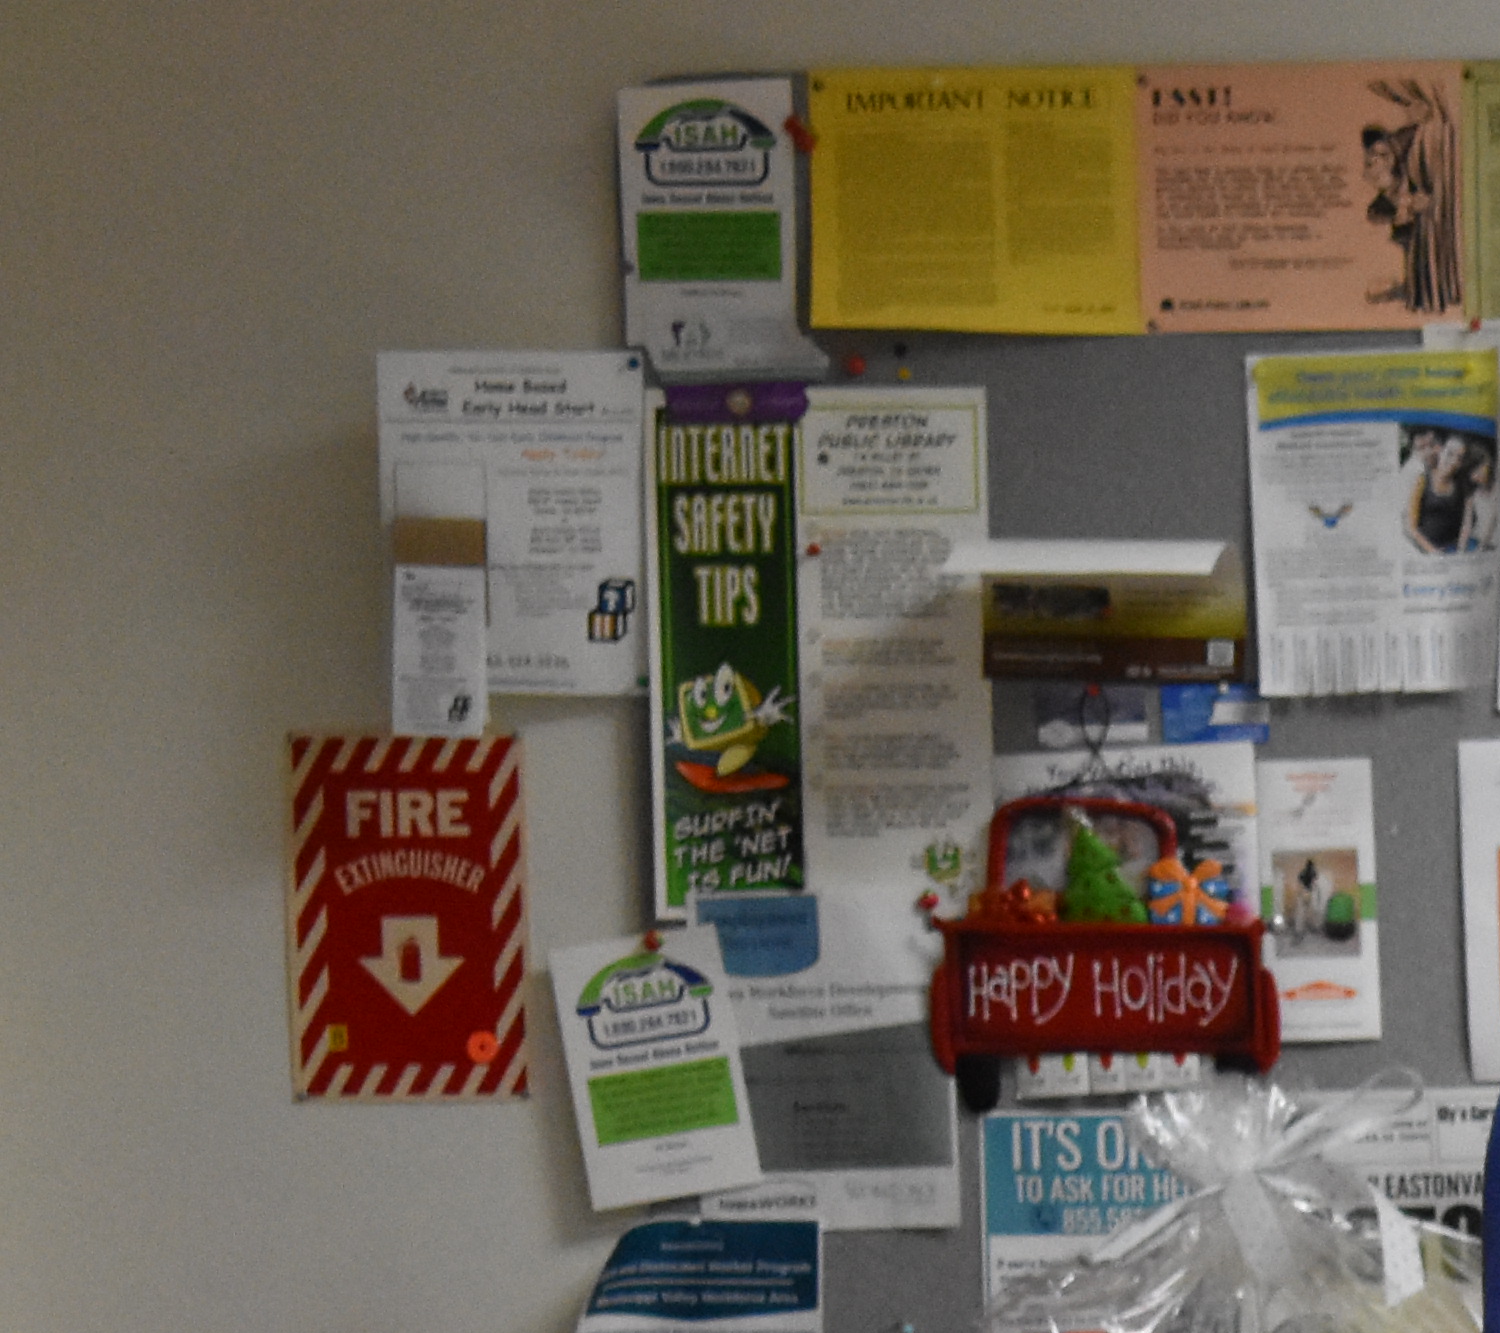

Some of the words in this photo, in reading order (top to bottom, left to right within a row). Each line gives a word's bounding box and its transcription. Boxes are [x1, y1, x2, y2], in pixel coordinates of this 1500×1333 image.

[846, 91, 984, 112] IMPORTANT
[1007, 87, 1093, 109] NOTICE
[461, 401, 502, 419] Early
[509, 401, 548, 415] Head
[555, 401, 595, 415] Start
[659, 425, 787, 483] INTERNET
[674, 493, 777, 555] SAFETY
[694, 564, 761, 628] TIPS
[345, 787, 472, 839] FIRE
[333, 847, 487, 897] EXTINGUISHER
[673, 840, 726, 868] THE
[612, 978, 676, 1005] ISAH
[967, 951, 1074, 1026] Happy
[1091, 952, 1239, 1027] Holiday
[1012, 1120, 1083, 1172] IT'S
[1015, 1175, 1045, 1205] TO
[1050, 1175, 1095, 1205] ASK
[1101, 1174, 1146, 1203] FOR
[1384, 1172, 1485, 1199] EASTONVA
